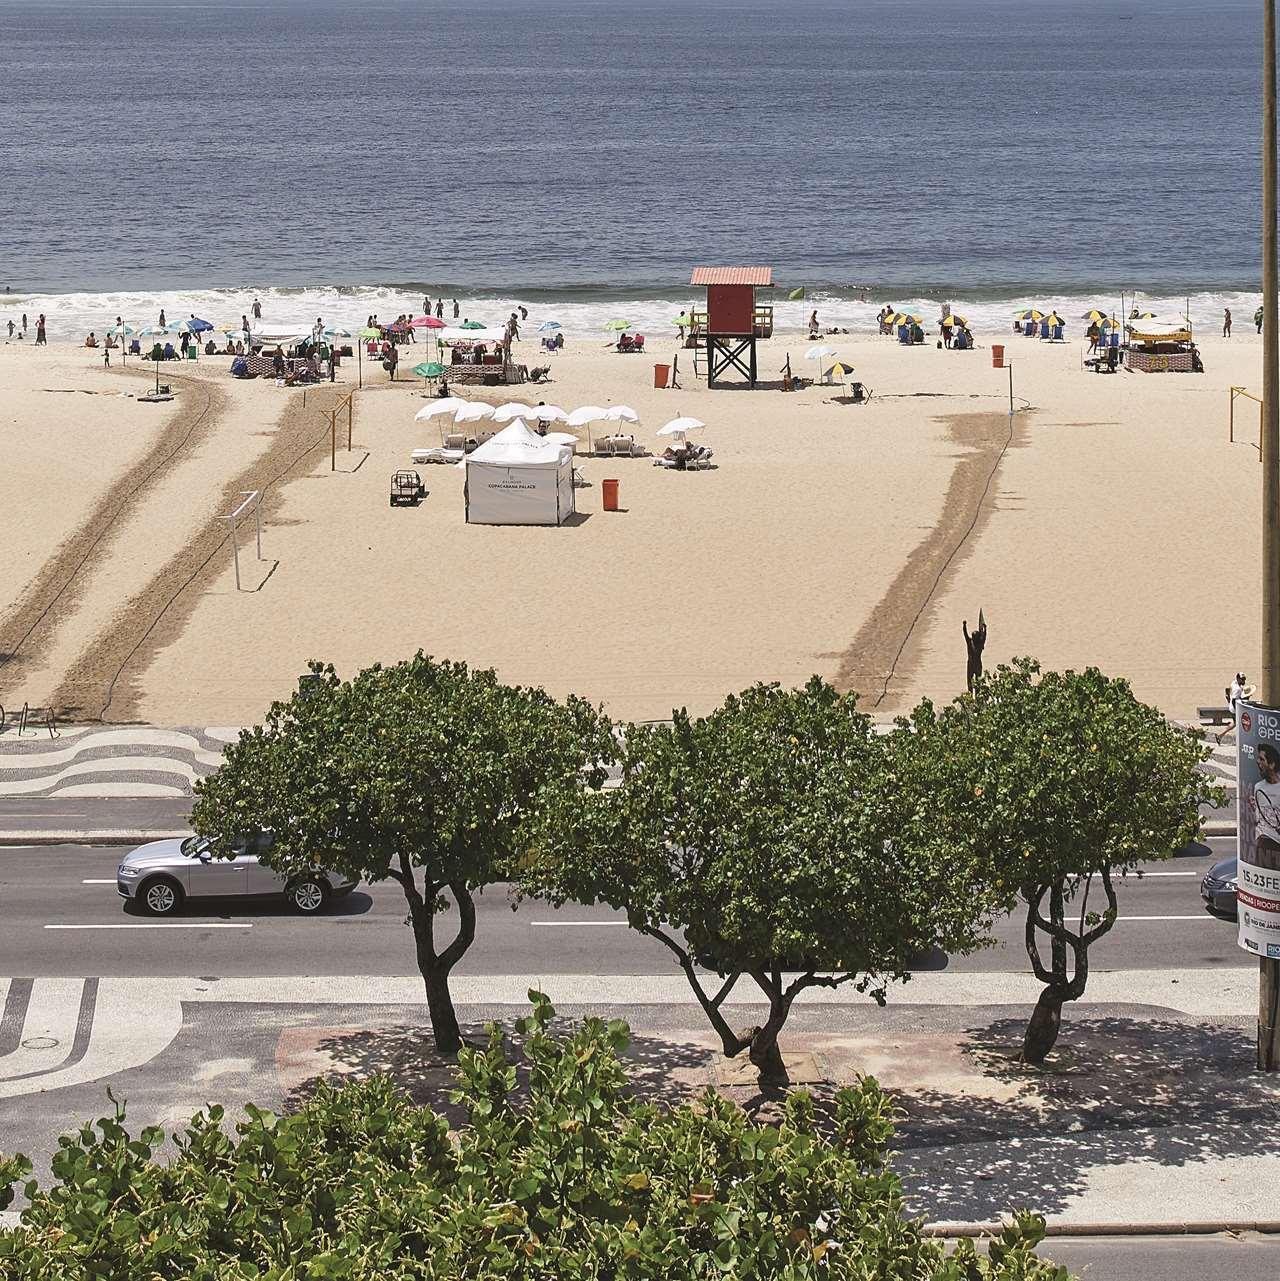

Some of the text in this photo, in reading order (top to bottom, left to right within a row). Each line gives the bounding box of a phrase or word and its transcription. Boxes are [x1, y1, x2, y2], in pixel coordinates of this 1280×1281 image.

[1257, 714, 1278, 728] RIO
[1242, 869, 1251, 883] 15
[1253, 873, 1265, 887] 23
